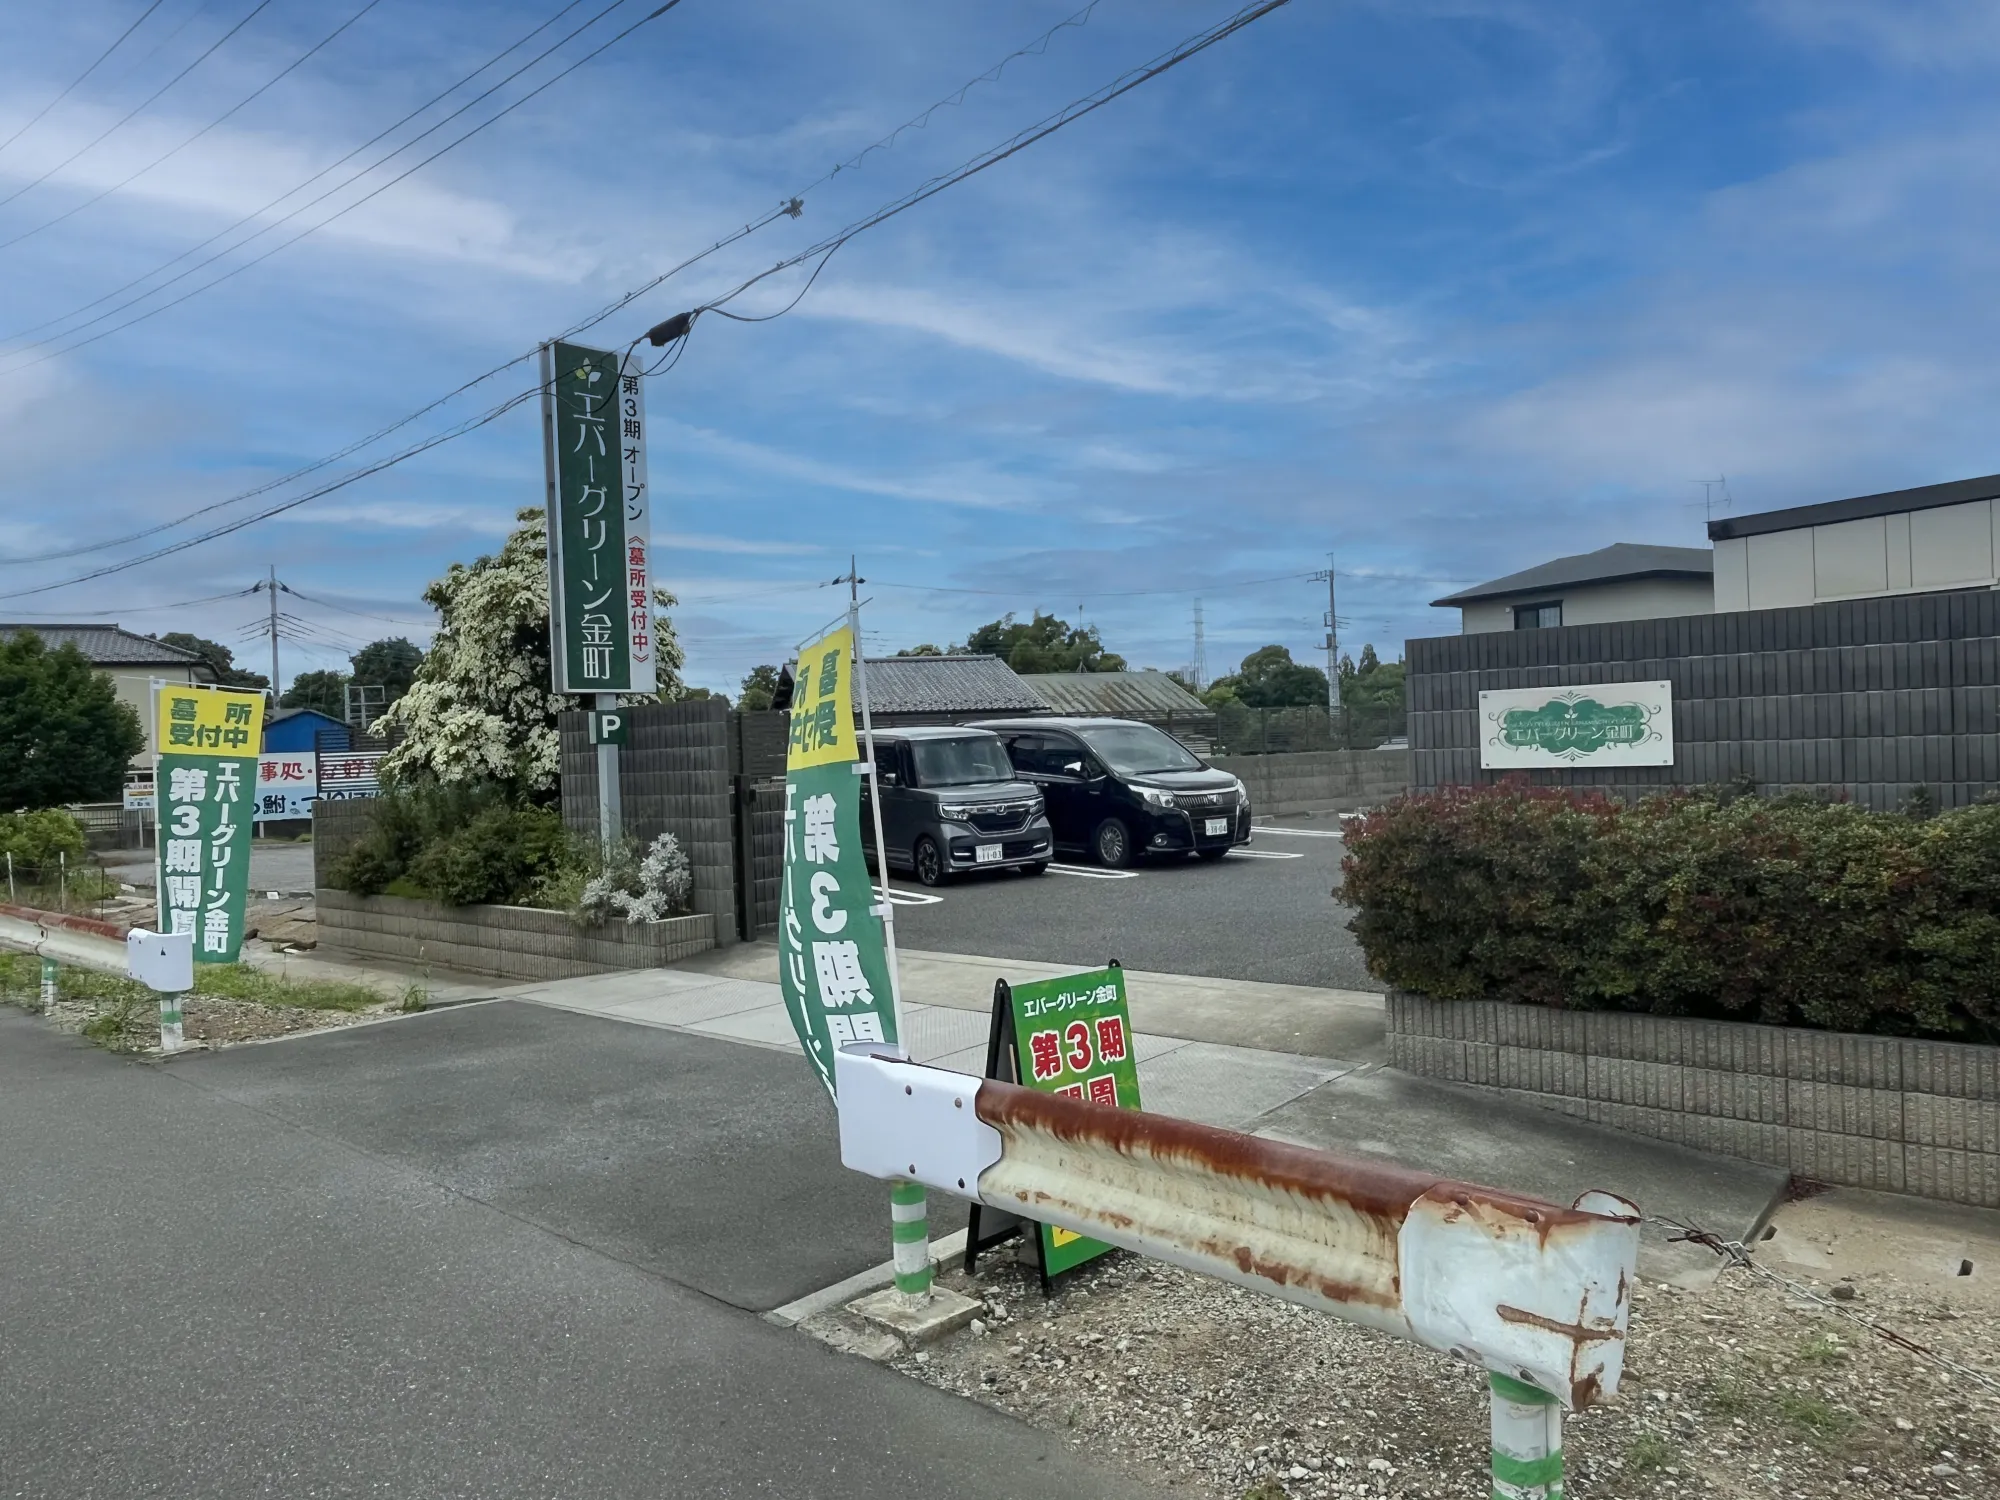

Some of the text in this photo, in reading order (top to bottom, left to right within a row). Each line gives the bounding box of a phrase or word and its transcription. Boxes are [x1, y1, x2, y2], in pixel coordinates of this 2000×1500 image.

[573, 391, 615, 680] エバーグリーン金町
[169, 722, 249, 749] 受付中
[602, 715, 621, 738] P
[1511, 725, 1634, 741] エバーグリーン金町
[204, 762, 241, 953] エバーグリーン金町
[1024, 984, 1117, 1017] エバーグリーン金町
[1029, 1014, 1126, 1082] 第3期
